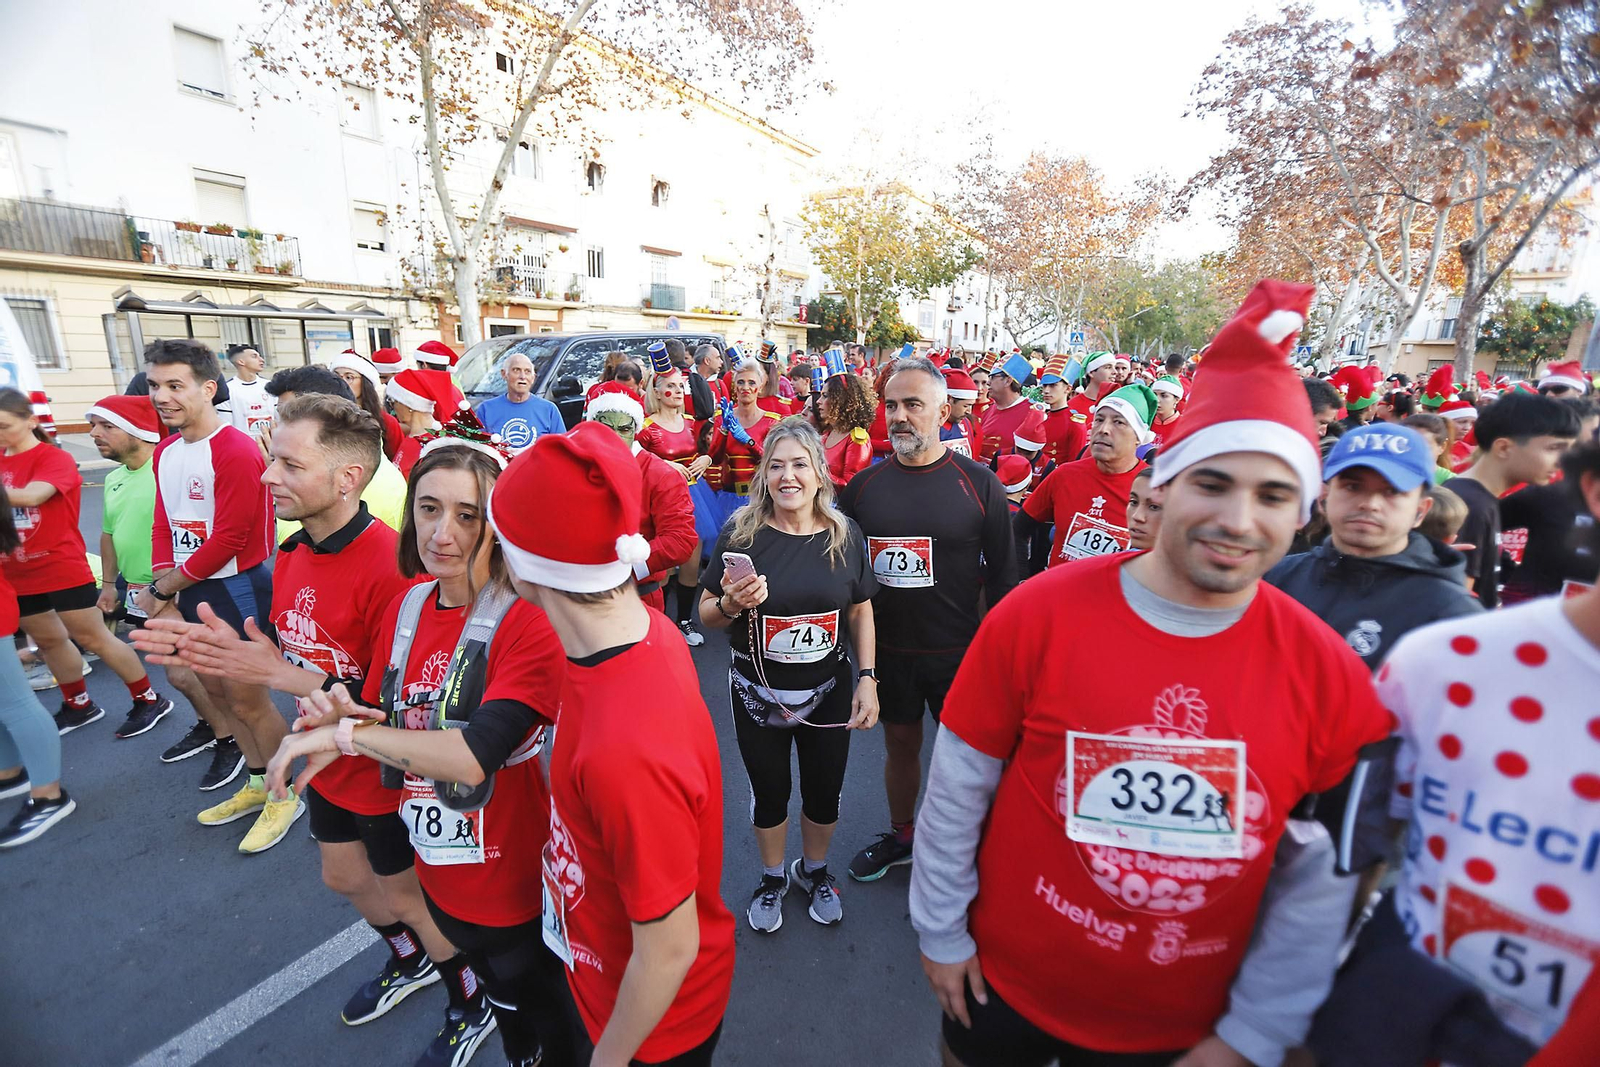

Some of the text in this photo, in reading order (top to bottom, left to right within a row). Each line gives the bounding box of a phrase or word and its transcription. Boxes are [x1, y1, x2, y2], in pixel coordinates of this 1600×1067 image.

[1349, 433, 1411, 454] NYC
[1083, 530, 1114, 553] 187
[885, 551, 908, 571] 73
[286, 610, 317, 641] XIII
[789, 626, 814, 648] 74
[1146, 753, 1174, 761] HUELVA
[1111, 767, 1197, 817] 332
[410, 804, 443, 838] 78
[1107, 848, 1134, 871] DE
[1135, 853, 1243, 881] DICIEMBRE
[1091, 858, 1207, 912] 2023
[1035, 876, 1127, 942] Huelva
[1490, 936, 1565, 1009] 51
